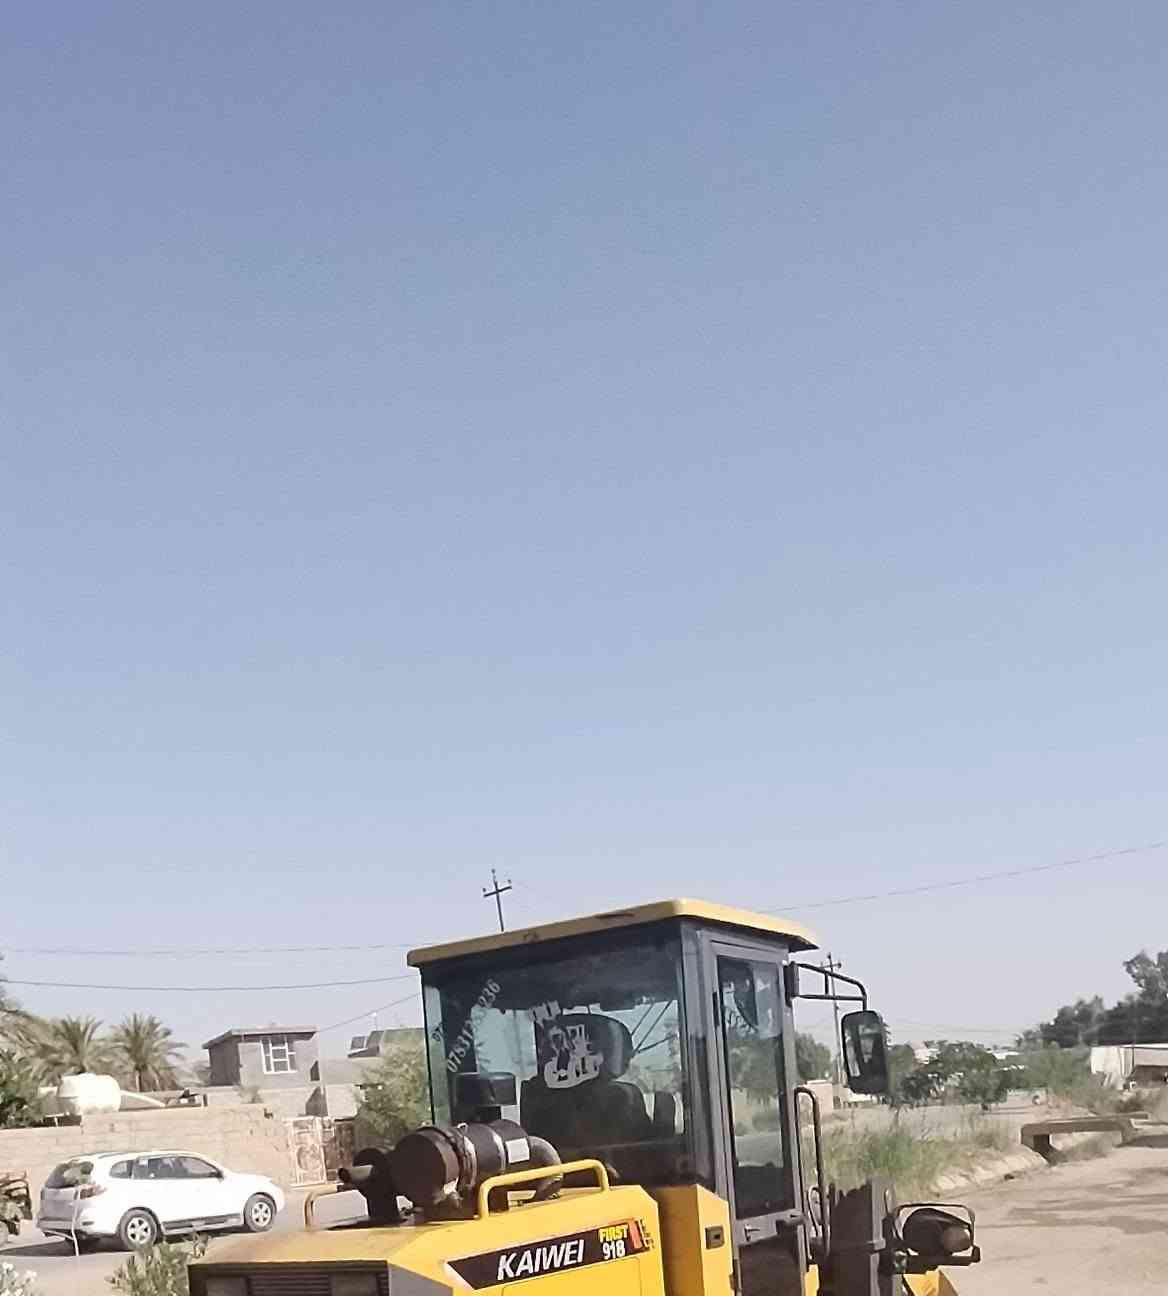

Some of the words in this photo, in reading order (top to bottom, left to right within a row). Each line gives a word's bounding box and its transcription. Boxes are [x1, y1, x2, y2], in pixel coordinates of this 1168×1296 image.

[599, 1225, 629, 1242] FIRST
[497, 1239, 585, 1281] KAIWEI
[602, 1240, 626, 1260] 918
